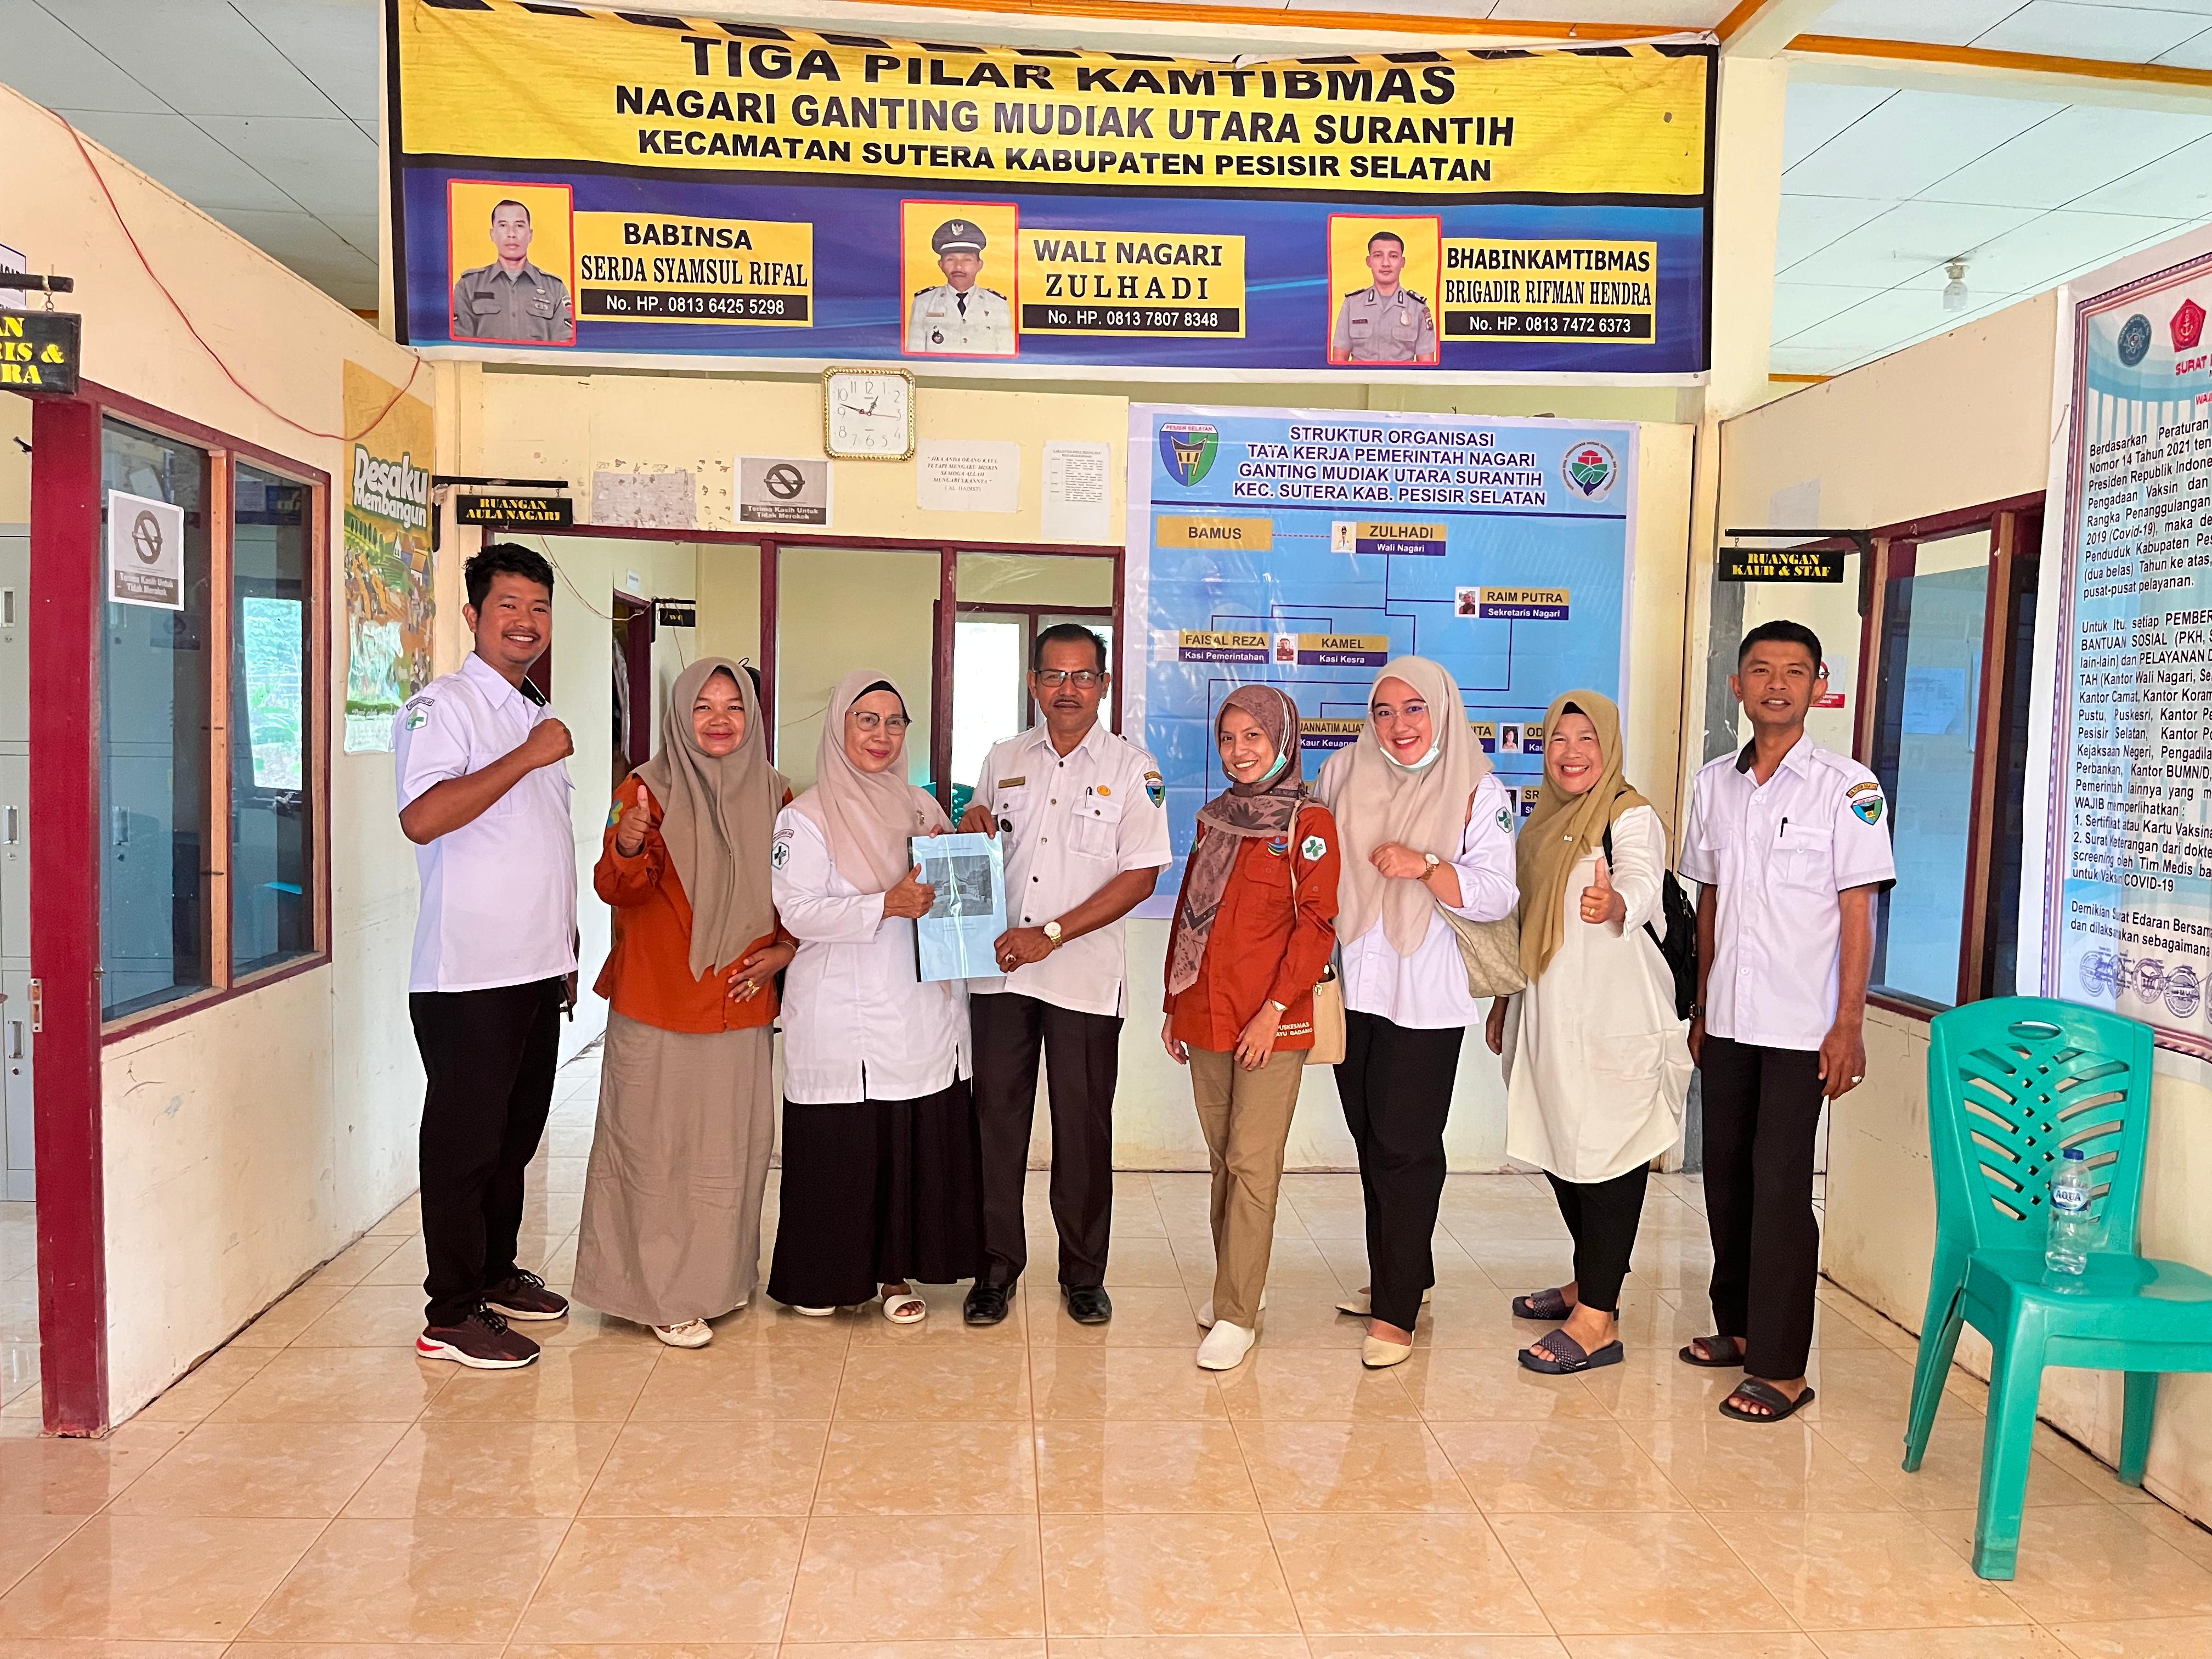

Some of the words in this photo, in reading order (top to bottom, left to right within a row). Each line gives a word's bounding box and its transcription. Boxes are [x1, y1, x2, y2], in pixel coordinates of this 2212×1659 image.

[681, 36, 839, 81] TIGA
[865, 54, 1054, 90] PILAR
[1076, 66, 1455, 105] KAMTIBMAS
[616, 85, 775, 123] NAGARI
[792, 95, 978, 132] GANTING
[994, 103, 1153, 138] MUDIAK
[1169, 109, 1300, 143] UTARA
[1314, 114, 1514, 146] SURANTIH
[639, 130, 850, 162] KECAMATAN
[862, 143, 993, 169] SUTERA
[1006, 148, 1204, 175] KABUPATEN
[1216, 155, 1339, 177] PESISIR
[1350, 156, 1491, 181] SELATAN
[624, 223, 752, 250] BABINSA
[1034, 240, 1106, 263] WALI
[1116, 242, 1222, 267] NAGARI
[1447, 249, 1650, 272] BHABINKAMTIBMAS
[581, 255, 645, 281] SERDA
[653, 258, 743, 285] SYAMSUL
[749, 262, 808, 287] RIFAL
[1046, 274, 1207, 300] ZULHADI
[1445, 280, 1521, 304] BRIGADIR
[1525, 281, 1585, 304] RIFMAN
[1589, 283, 1651, 306] HENDRA
[606, 295, 631, 311] No.
[636, 296, 663, 313] HP.
[668, 297, 704, 313] 0813
[708, 298, 744, 314] 6425
[749, 299, 785, 315] 5298
[1048, 309, 1071, 325] No.
[1076, 311, 1102, 326] HP.
[1107, 311, 1141, 326] 0813
[1146, 312, 1180, 327] 7807
[1184, 312, 1218, 327] 8348
[1469, 317, 1492, 331] No.
[1498, 317, 1521, 331] HP.
[1525, 317, 1559, 332] 0813
[1563, 318, 1595, 332] 7472
[1599, 318, 1630, 333] 6373
[41, 344, 64, 364] &
[2175, 356, 2207, 375] SURAT
[838, 389, 848, 401] 10
[894, 391, 900, 403] 2
[865, 381, 873, 394] 12
[838, 407, 845, 419] 9
[839, 426, 847, 438] 8
[1290, 427, 1383, 442] STRUKTUR
[1389, 431, 1493, 446] ORGANISASI
[2090, 435, 2147, 456] Berdasarkan
[2159, 419, 2209, 439] Peraturan
[1248, 444, 1289, 458] TATA
[1294, 446, 1350, 461] KERJA
[1355, 449, 1463, 464] PEMERINTAH
[1470, 452, 1534, 466] NAGARI
[2090, 459, 2119, 474] Nomor
[2136, 448, 2163, 464] Tahun
[2167, 439, 2190, 457] 2021
[354, 448, 428, 504] Desaku
[1239, 464, 1316, 478] GANTING
[1322, 466, 1390, 482] MUDIAK
[1395, 469, 1451, 483] UTARA
[1456, 470, 1542, 486] SURANTIH
[2089, 474, 2127, 492] Presiden
[2131, 464, 2172, 483] Republik
[1234, 483, 1273, 496] KEC.
[1279, 484, 1348, 499] SUTERA
[1353, 487, 1392, 500] KAB.
[1400, 488, 1464, 503] PESISIR
[1470, 490, 1545, 505] SELATAN
[2088, 491, 2137, 510] Pengadaan
[2146, 481, 2177, 498] Vaksin
[354, 486, 426, 528] Membangun
[480, 499, 546, 509] RUANGAN
[2087, 511, 2120, 527] Rangka
[2126, 496, 2210, 521] Penanggulangan
[466, 509, 503, 519] AULA
[506, 511, 560, 521] NAGARI
[1189, 527, 1242, 539] BAMUS
[1369, 526, 1433, 539] ZULHADI
[2086, 531, 2106, 545] 2019
[2109, 522, 2158, 544] (Covid-19),
[1377, 543, 1395, 551] Wali
[1397, 544, 1424, 552] Nagari
[2085, 545, 2130, 563] Penduduk
[2136, 537, 2188, 555] Kabupaten
[1748, 554, 1819, 565] RUANGAN
[2085, 568, 2103, 583] (dua
[2106, 562, 2133, 577] belas)
[2140, 559, 2166, 573] Tahun
[2187, 554, 2211, 567] atas,
[1732, 565, 1774, 575] KAUR
[1779, 566, 1790, 575] &
[1794, 566, 1831, 576] STAF
[1487, 591, 1517, 602] RAIM
[1522, 592, 1562, 602] PUTRA
[2084, 580, 2136, 601] pusat-pusat
[2139, 576, 2193, 595] pelayanan.
[1488, 608, 1531, 617] Sekretaris
[1533, 609, 1560, 618] Nagari
[2082, 619, 2107, 633] Untuk
[2132, 615, 2159, 630] setiap
[1185, 635, 1228, 645] FAISAL
[1233, 636, 1265, 646] REZA
[1322, 638, 1364, 648] KAMEL
[2081, 636, 2126, 651] BANTUAN
[2132, 633, 2167, 647] SOSIAL
[2175, 630, 2205, 647] (PKH,
[1206, 652, 1264, 661] Pemerintahan
[2080, 654, 2118, 669] lain-lain)
[2140, 649, 2204, 665] PELAYANAN
[2078, 744, 2120, 759] Kejaksaan
[2123, 745, 2153, 760] Negeri,
[2167, 765, 2211, 781] BUMN/D,
[2143, 820, 2171, 834] Kartu
[2140, 857, 2159, 871] Tim
[2163, 860, 2192, 876] Medis
[2124, 873, 2174, 892] COVID-19
[2132, 912, 2169, 930] Edaran
[2142, 934, 2209, 957] sebagaimana
[2056, 1190, 2081, 1203] AQUA
